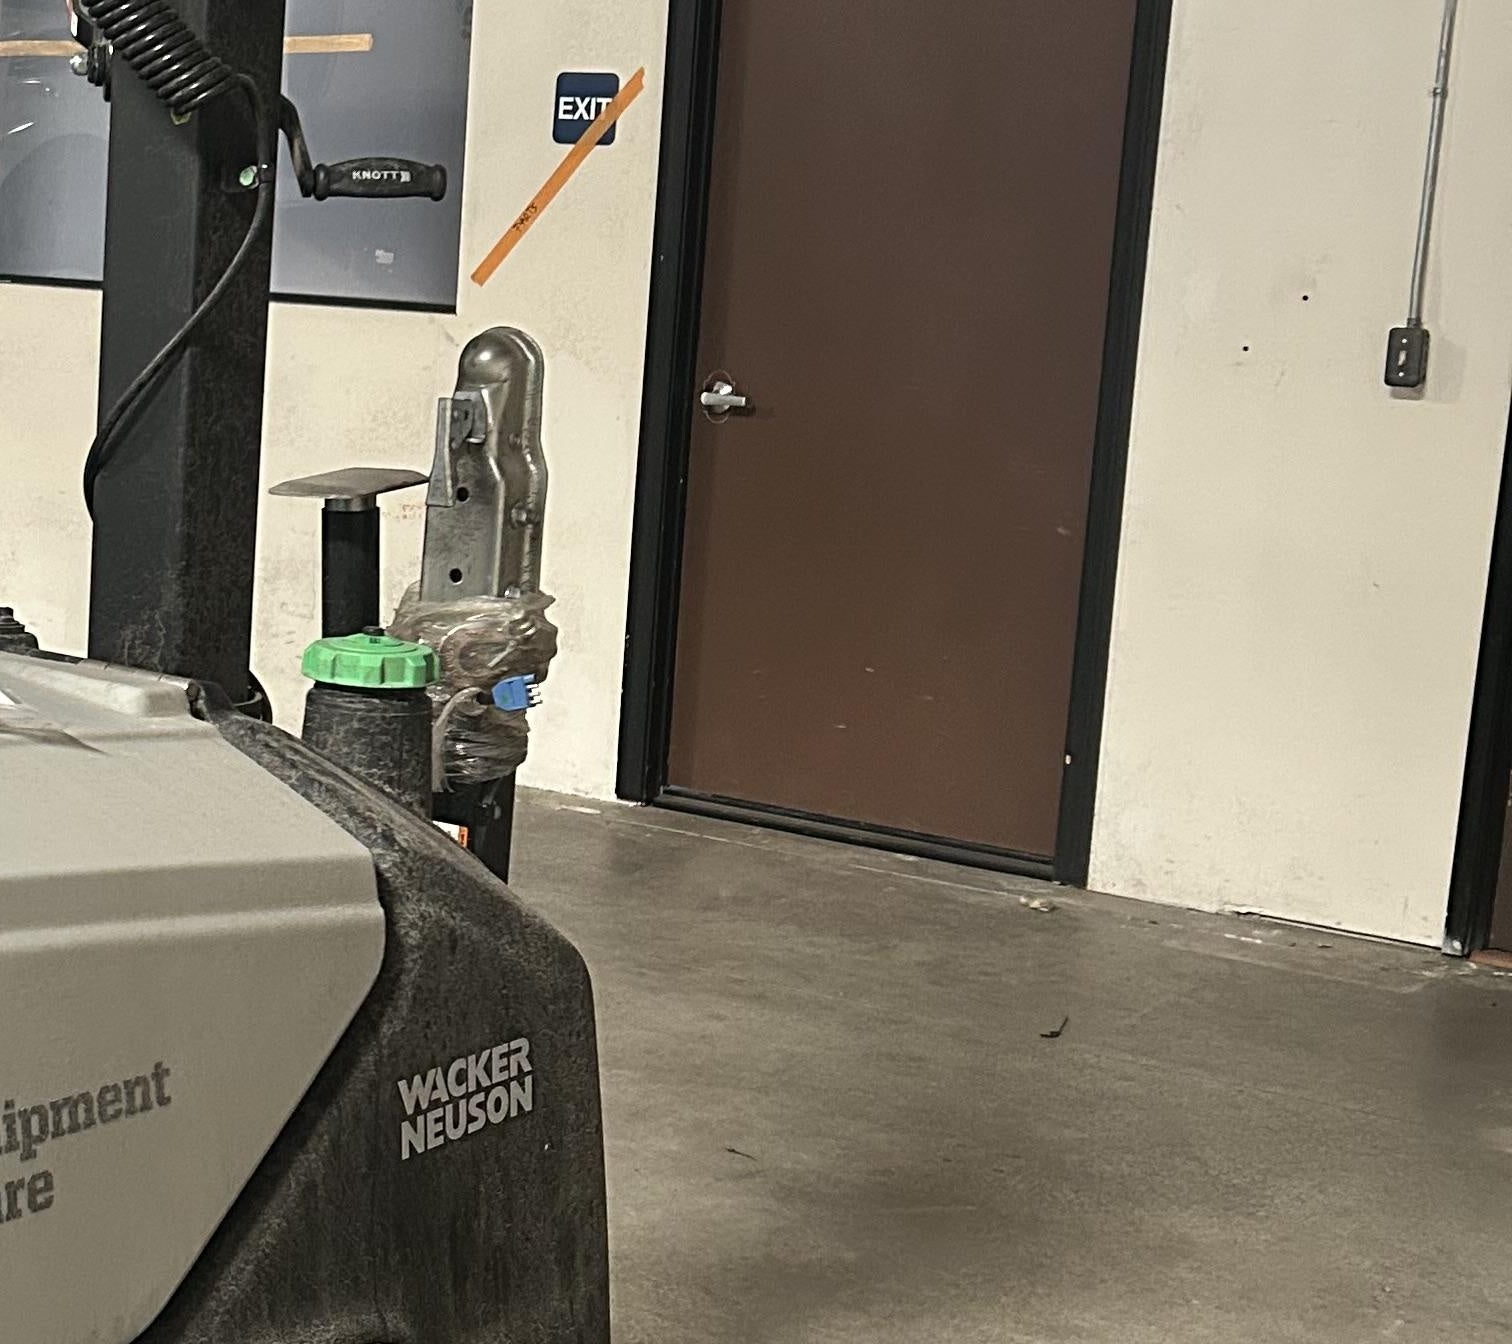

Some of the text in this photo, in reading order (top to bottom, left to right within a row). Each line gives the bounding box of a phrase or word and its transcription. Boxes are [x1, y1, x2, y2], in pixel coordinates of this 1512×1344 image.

[557, 96, 613, 121] EXIT
[352, 170, 401, 180] KNOTT
[397, 1037, 533, 1116] WACKER
[401, 1074, 533, 1161] NEUSON
